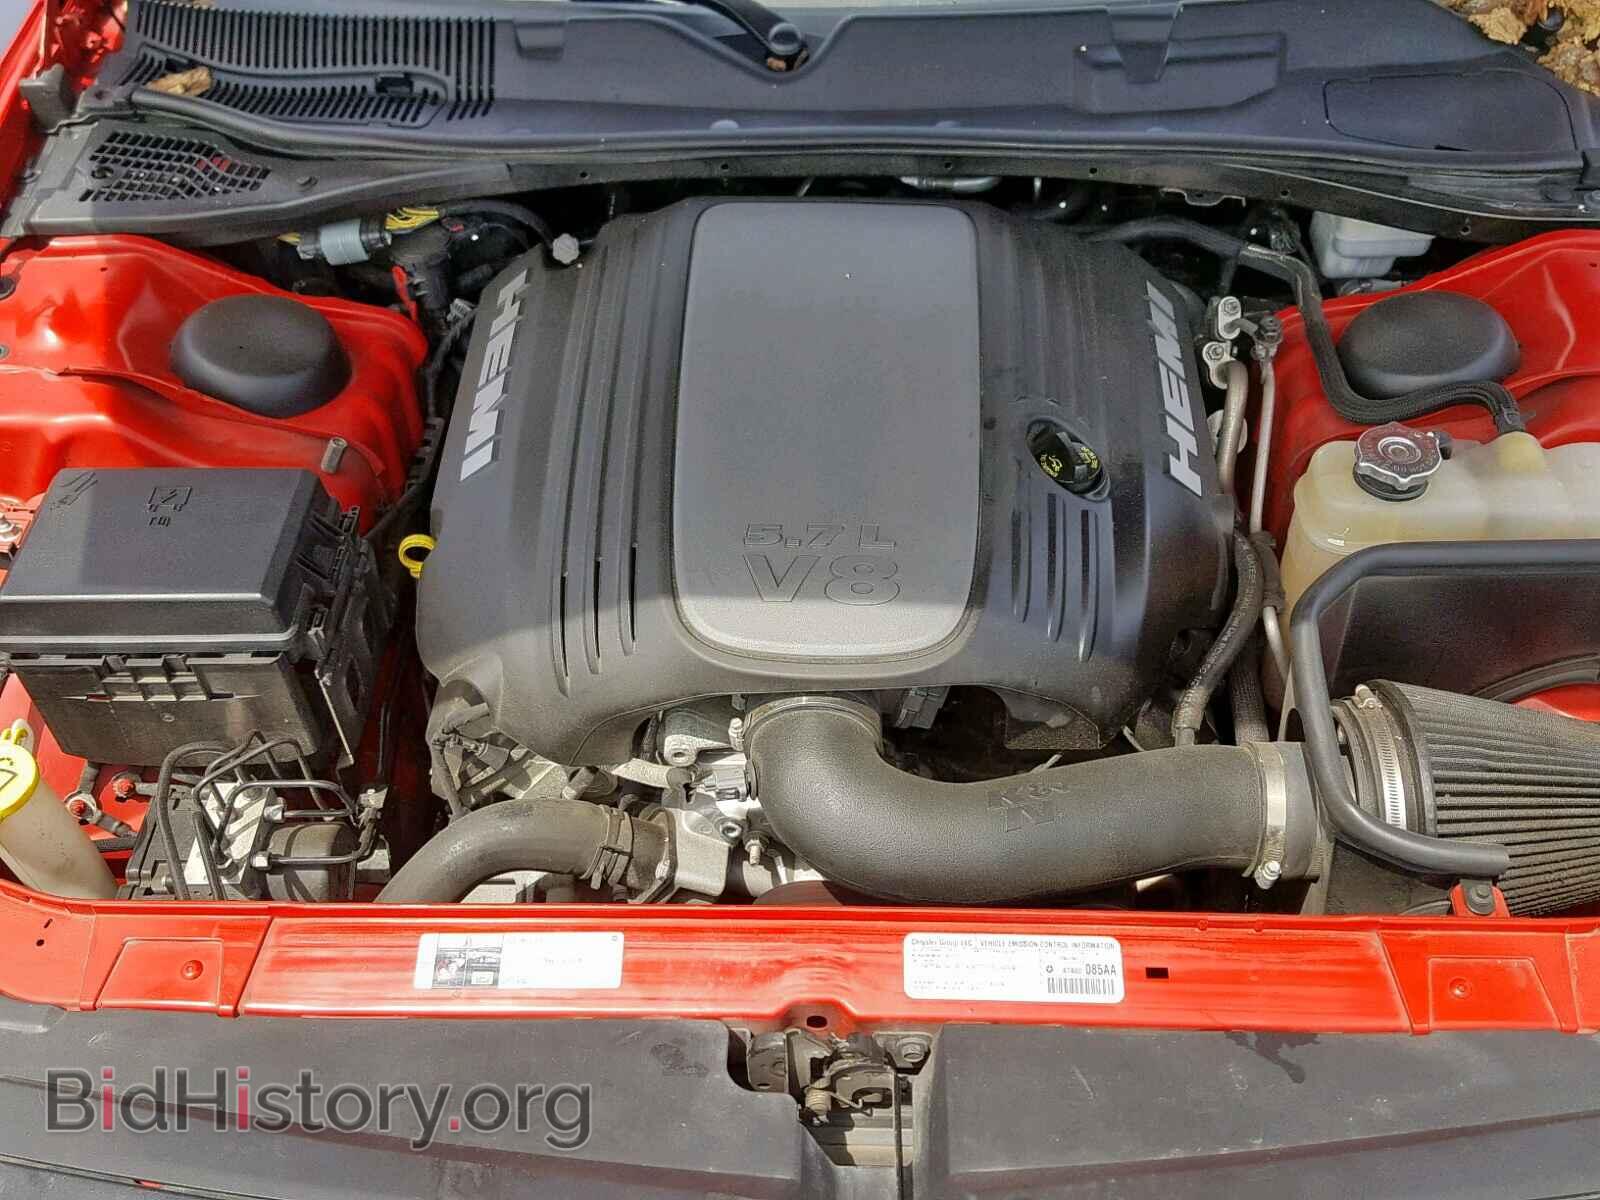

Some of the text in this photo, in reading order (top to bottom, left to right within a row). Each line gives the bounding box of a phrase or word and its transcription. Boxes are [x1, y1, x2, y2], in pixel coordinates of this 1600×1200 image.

[460, 269, 528, 481] HEMI
[1146, 280, 1202, 497] HEMI
[743, 522, 897, 550] 5.7 L
[742, 553, 900, 606] V8
[1072, 942, 1115, 951] INFORMATION
